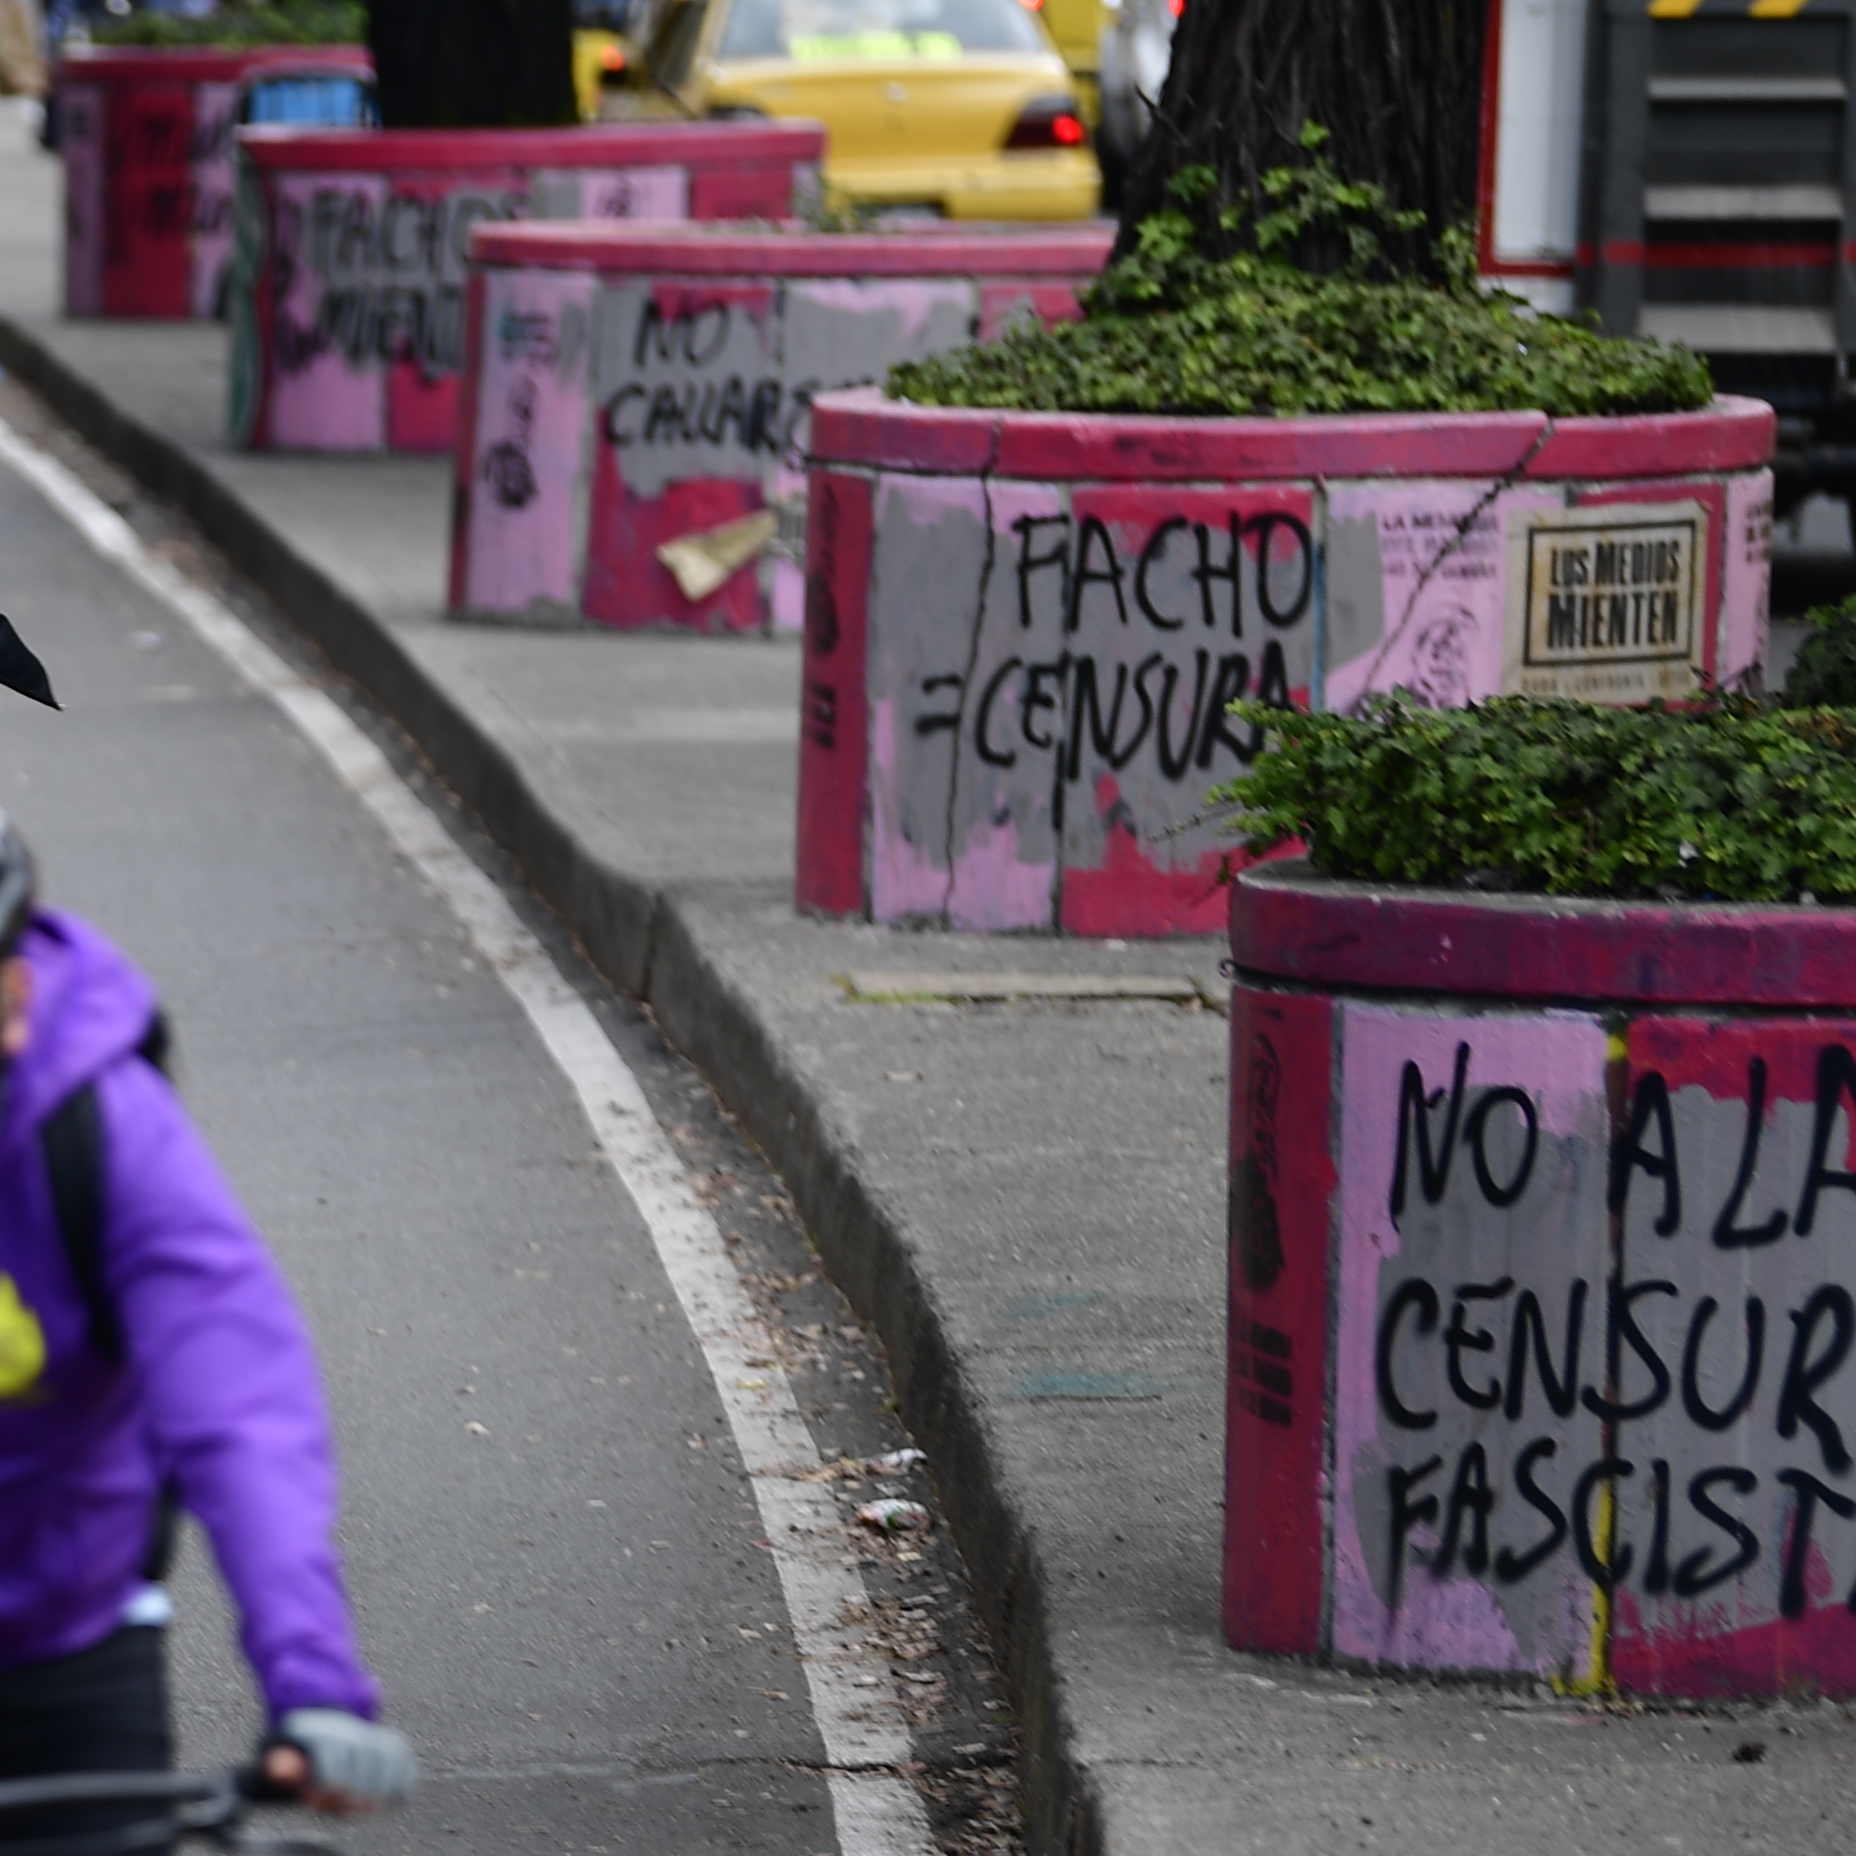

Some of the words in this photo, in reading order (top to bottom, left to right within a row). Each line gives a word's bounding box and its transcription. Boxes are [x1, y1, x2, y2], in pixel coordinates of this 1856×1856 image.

[633, 296, 732, 371] NO
[1009, 510, 1314, 637] FACHO
[1547, 589, 1678, 649] MIENTEN
[1550, 547, 1590, 587] LOS
[1595, 539, 1681, 586] MEDIOS
[1389, 1042, 1538, 1232] NO
[1376, 1277, 1856, 1475] CENSUR
[1386, 1438, 1856, 1622] FASCIST
